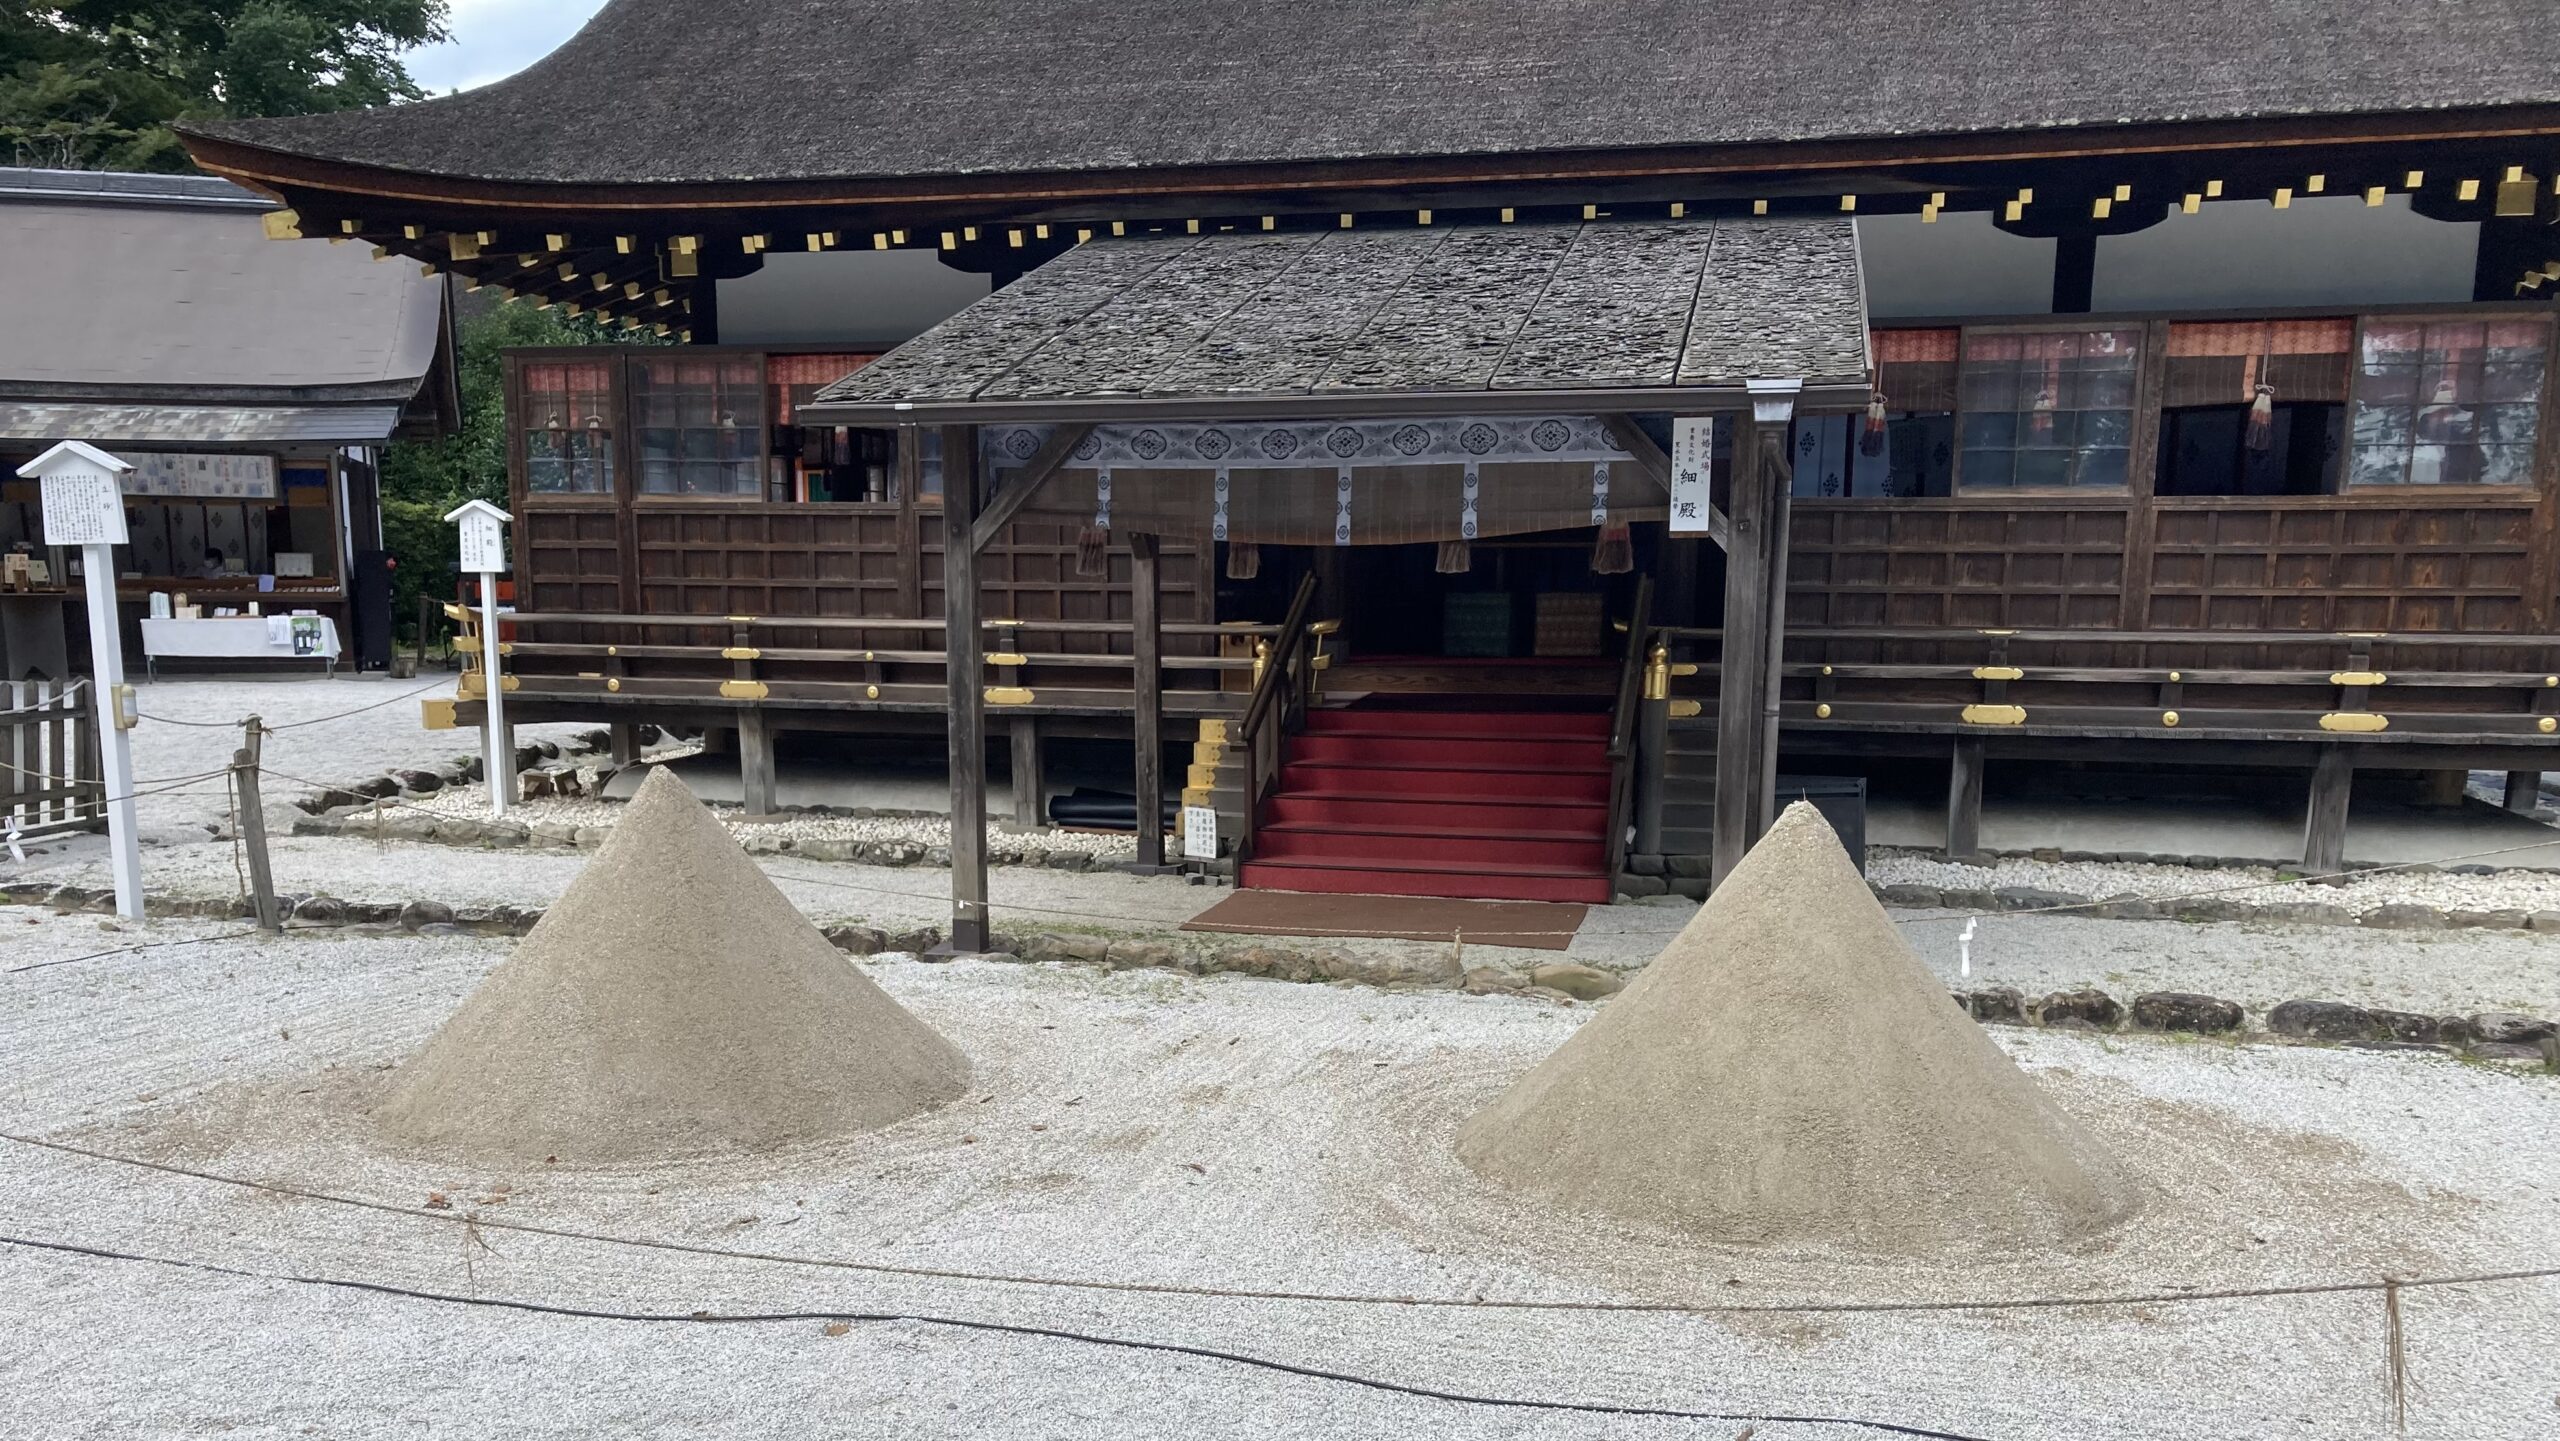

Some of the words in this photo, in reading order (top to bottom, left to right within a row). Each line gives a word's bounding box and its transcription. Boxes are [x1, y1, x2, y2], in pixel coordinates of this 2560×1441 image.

[1687, 427, 1696, 464] 重要文化財
[1700, 426, 1712, 471] 結婚式場
[1678, 468, 1698, 519] 細殿
